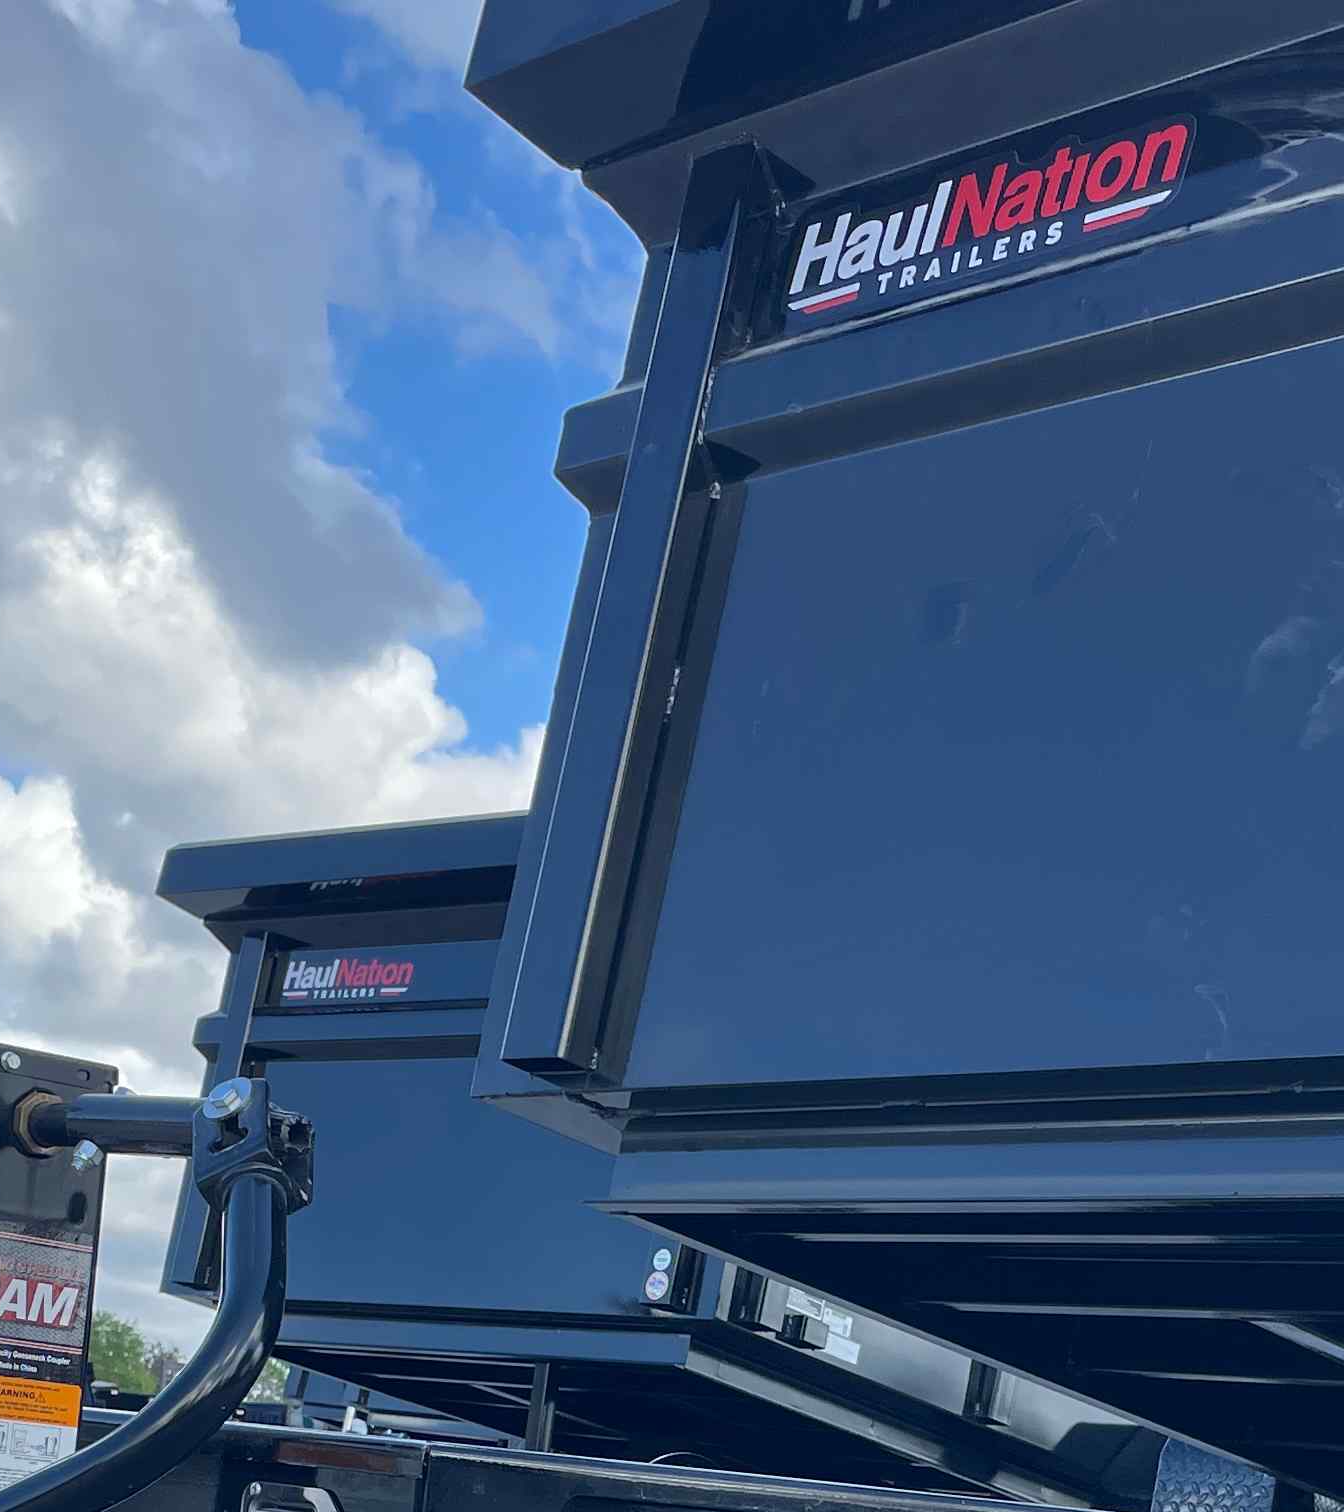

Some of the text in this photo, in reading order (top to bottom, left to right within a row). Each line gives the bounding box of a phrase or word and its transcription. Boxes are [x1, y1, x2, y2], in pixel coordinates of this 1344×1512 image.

[789, 122, 1188, 296] HaulNation
[877, 220, 1064, 296] TRAILERS
[282, 958, 414, 990] HaulNation
[313, 987, 376, 1000] TRAILERS
